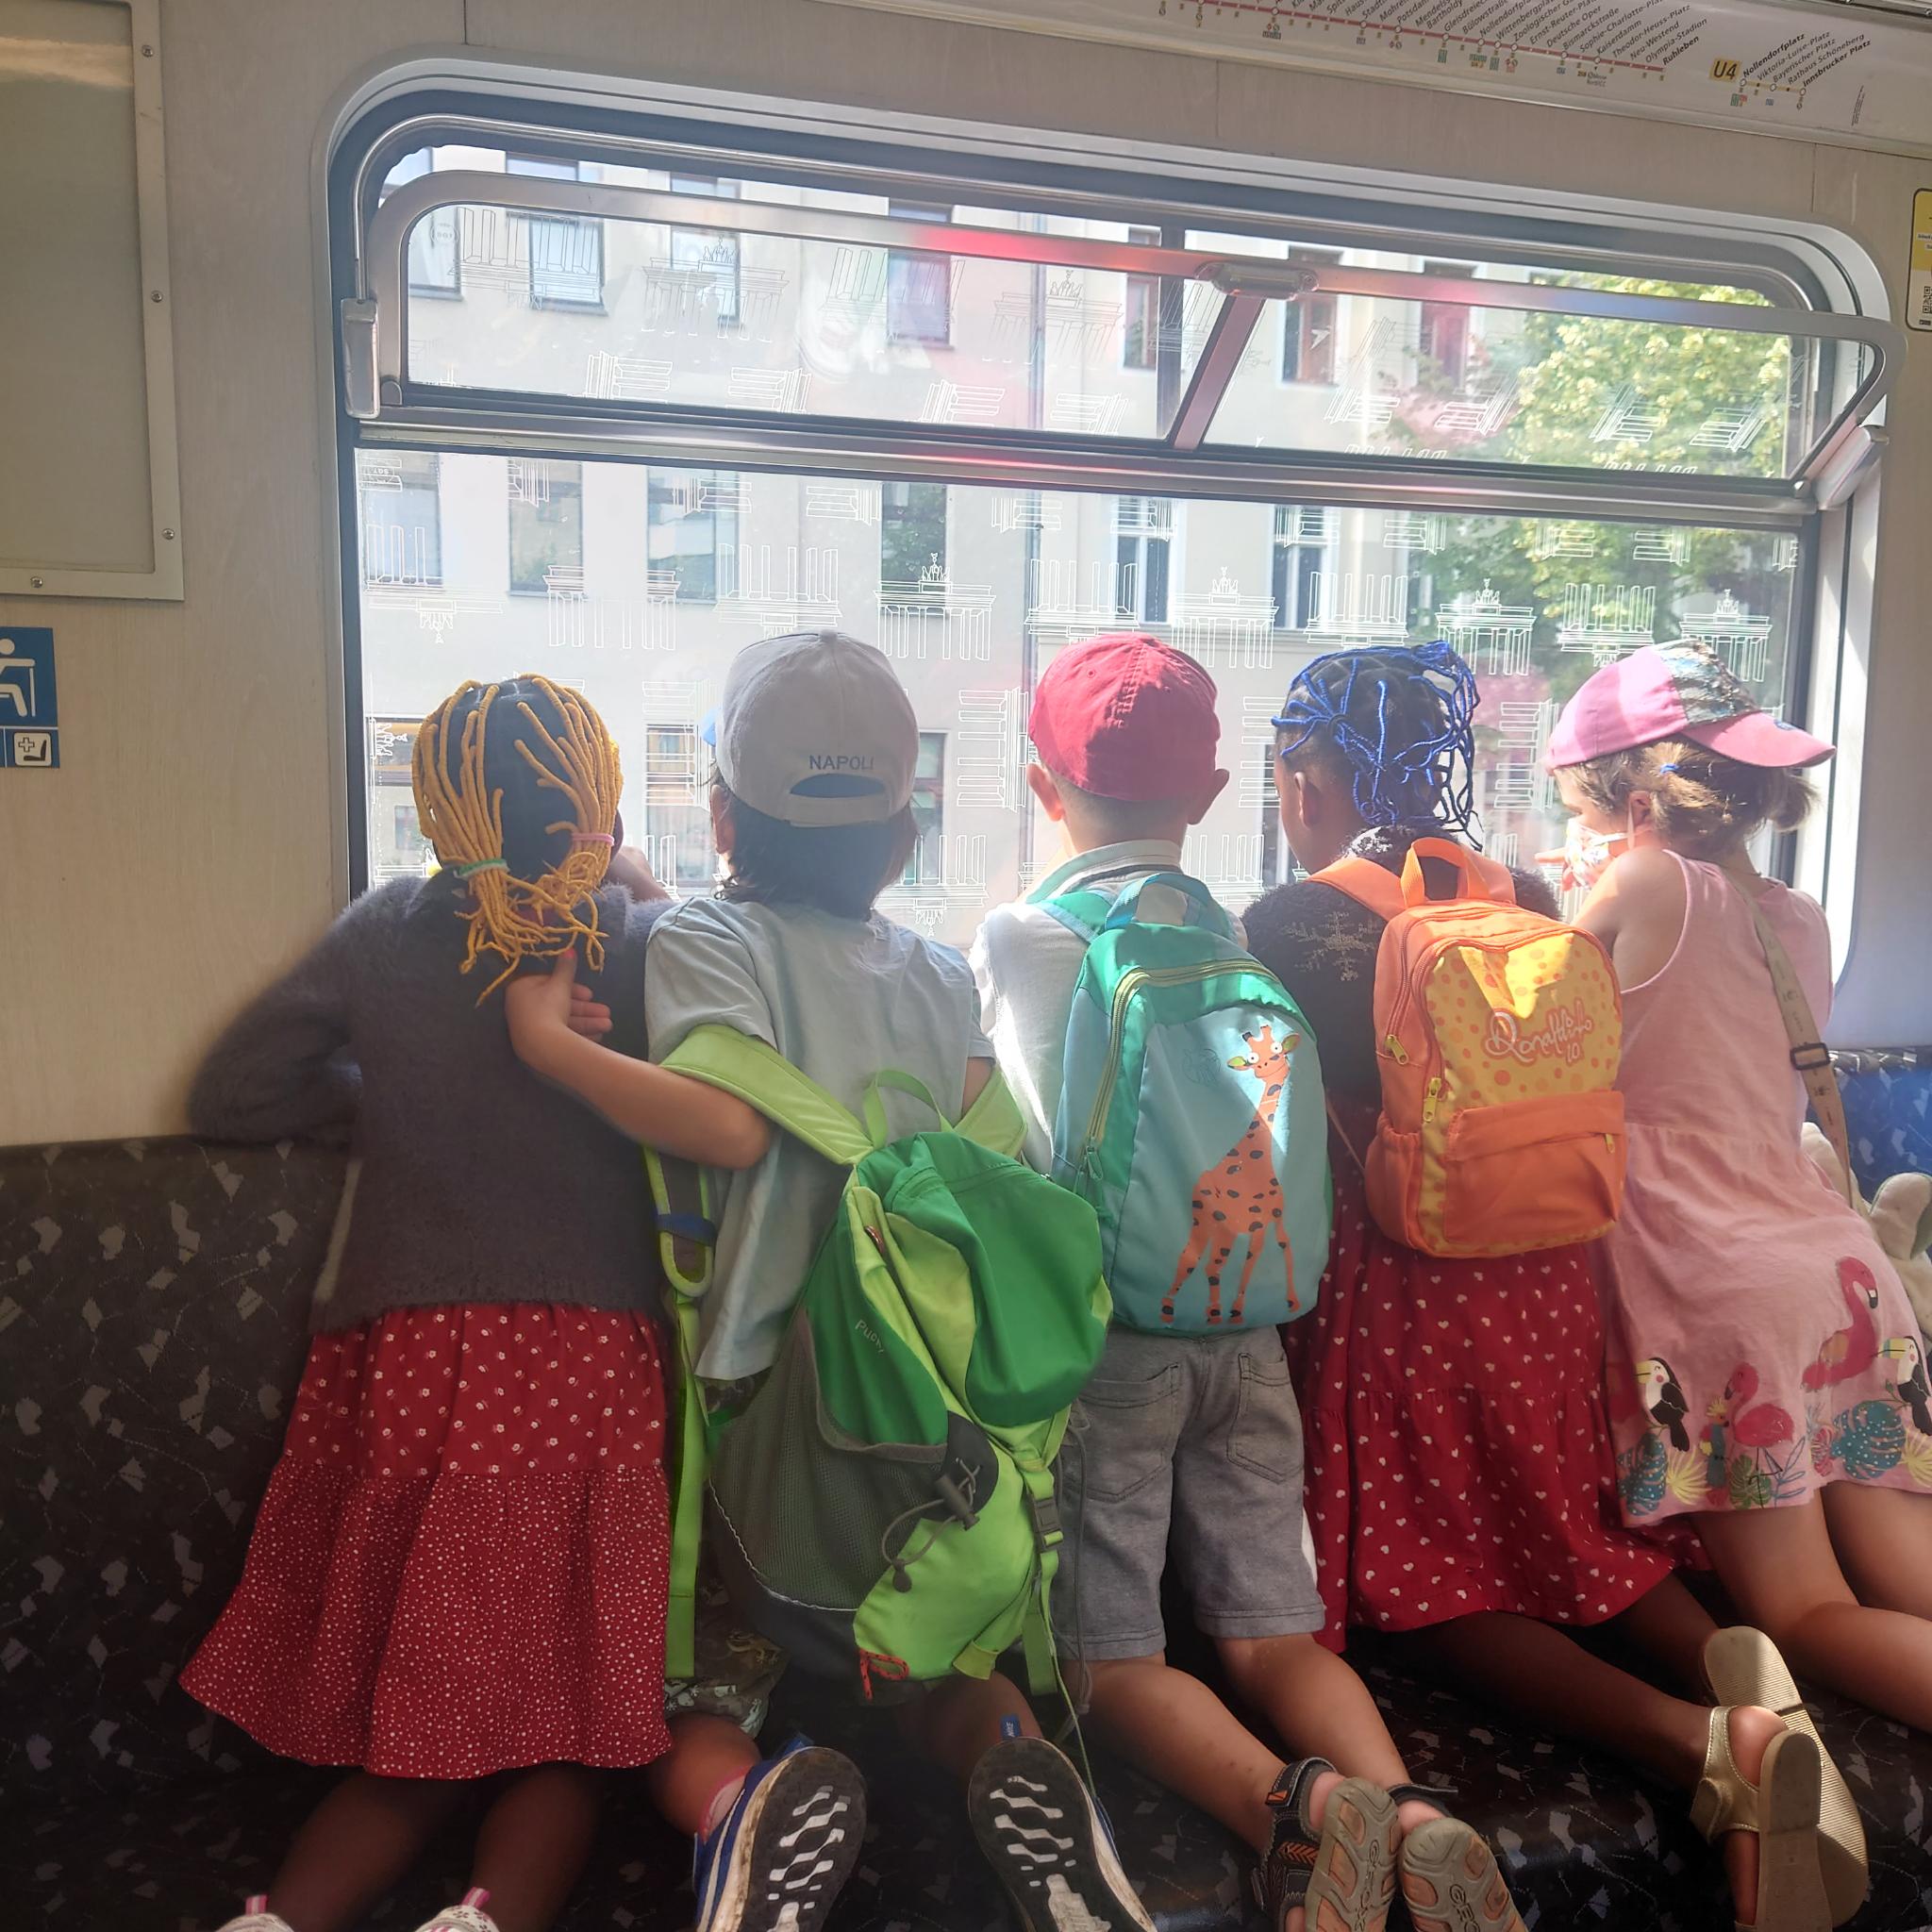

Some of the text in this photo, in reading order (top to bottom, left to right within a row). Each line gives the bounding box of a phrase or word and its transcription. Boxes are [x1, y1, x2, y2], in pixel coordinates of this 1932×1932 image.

[1513, 4, 1561, 42] Zoologischer
[1546, 6, 1602, 48] Deutsche Oper
[1562, 8, 1620, 51] Bismarckstraße
[1596, 19, 1642, 55] Kaiserdamm
[1612, 5, 1690, 58] Theodor-Heuss-Platz
[1630, 21, 1680, 60] Neu-Westend
[1645, 18, 1707, 63] Olympia-Stadion
[1662, 36, 1700, 65] Ruhleben
[1713, 60, 1738, 80] U4
[1742, 33, 1806, 78] Nollendorfplatz
[1757, 31, 1831, 81] Viktoria-Luise-Platz
[1773, 38, 1837, 83] Bayerischer Platz
[1803, 39, 1872, 88] Innsbrucker Platz
[1788, 60, 1818, 86] Rathaus
[808, 755, 875, 771] NAPOLI
